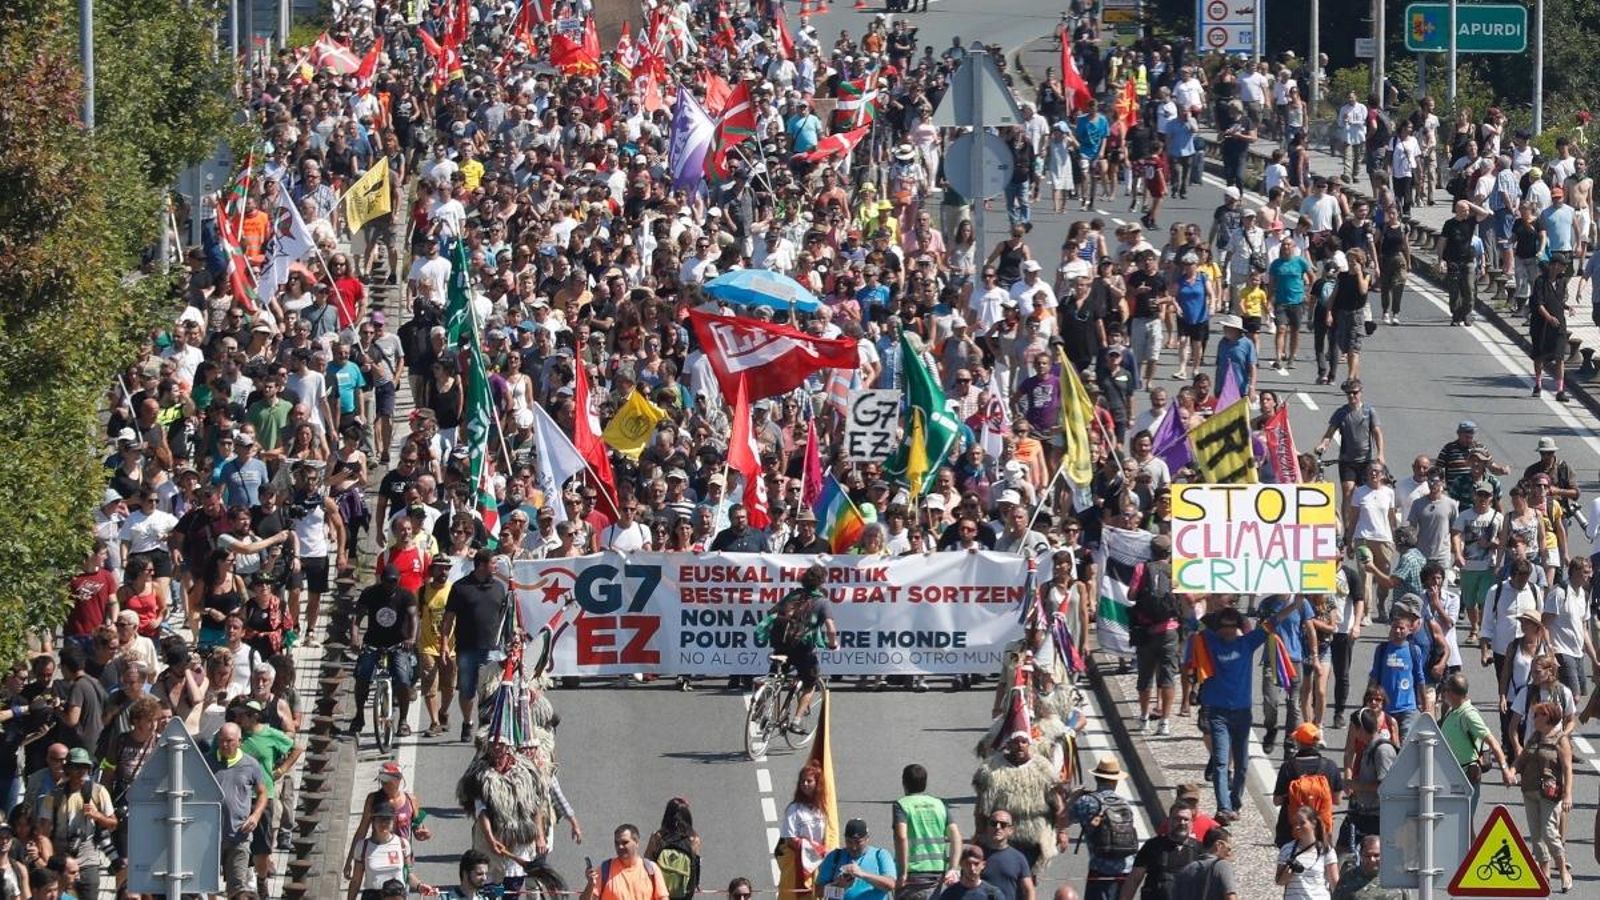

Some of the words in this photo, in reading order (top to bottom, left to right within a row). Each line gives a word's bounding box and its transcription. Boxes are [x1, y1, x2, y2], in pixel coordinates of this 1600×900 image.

[1458, 23, 1520, 36] APURDI
[853, 392, 898, 429] G7
[849, 431, 890, 457] EZ
[1174, 486, 1330, 524] STOP
[1175, 521, 1336, 561] CLIMATE
[680, 566, 773, 583] EUSKAL
[574, 564, 662, 615] G7
[681, 587, 753, 604] BESTE
[852, 586, 901, 603] BAT
[907, 586, 1024, 603] SORTZEN
[681, 609, 734, 627] NON
[577, 615, 661, 666] EZ
[680, 631, 748, 648] POUR
[877, 631, 966, 648] MONDE
[680, 652, 705, 665] NO
[711, 652, 732, 665] AL
[909, 652, 958, 665] OTRO
[963, 652, 1001, 665] MUN
